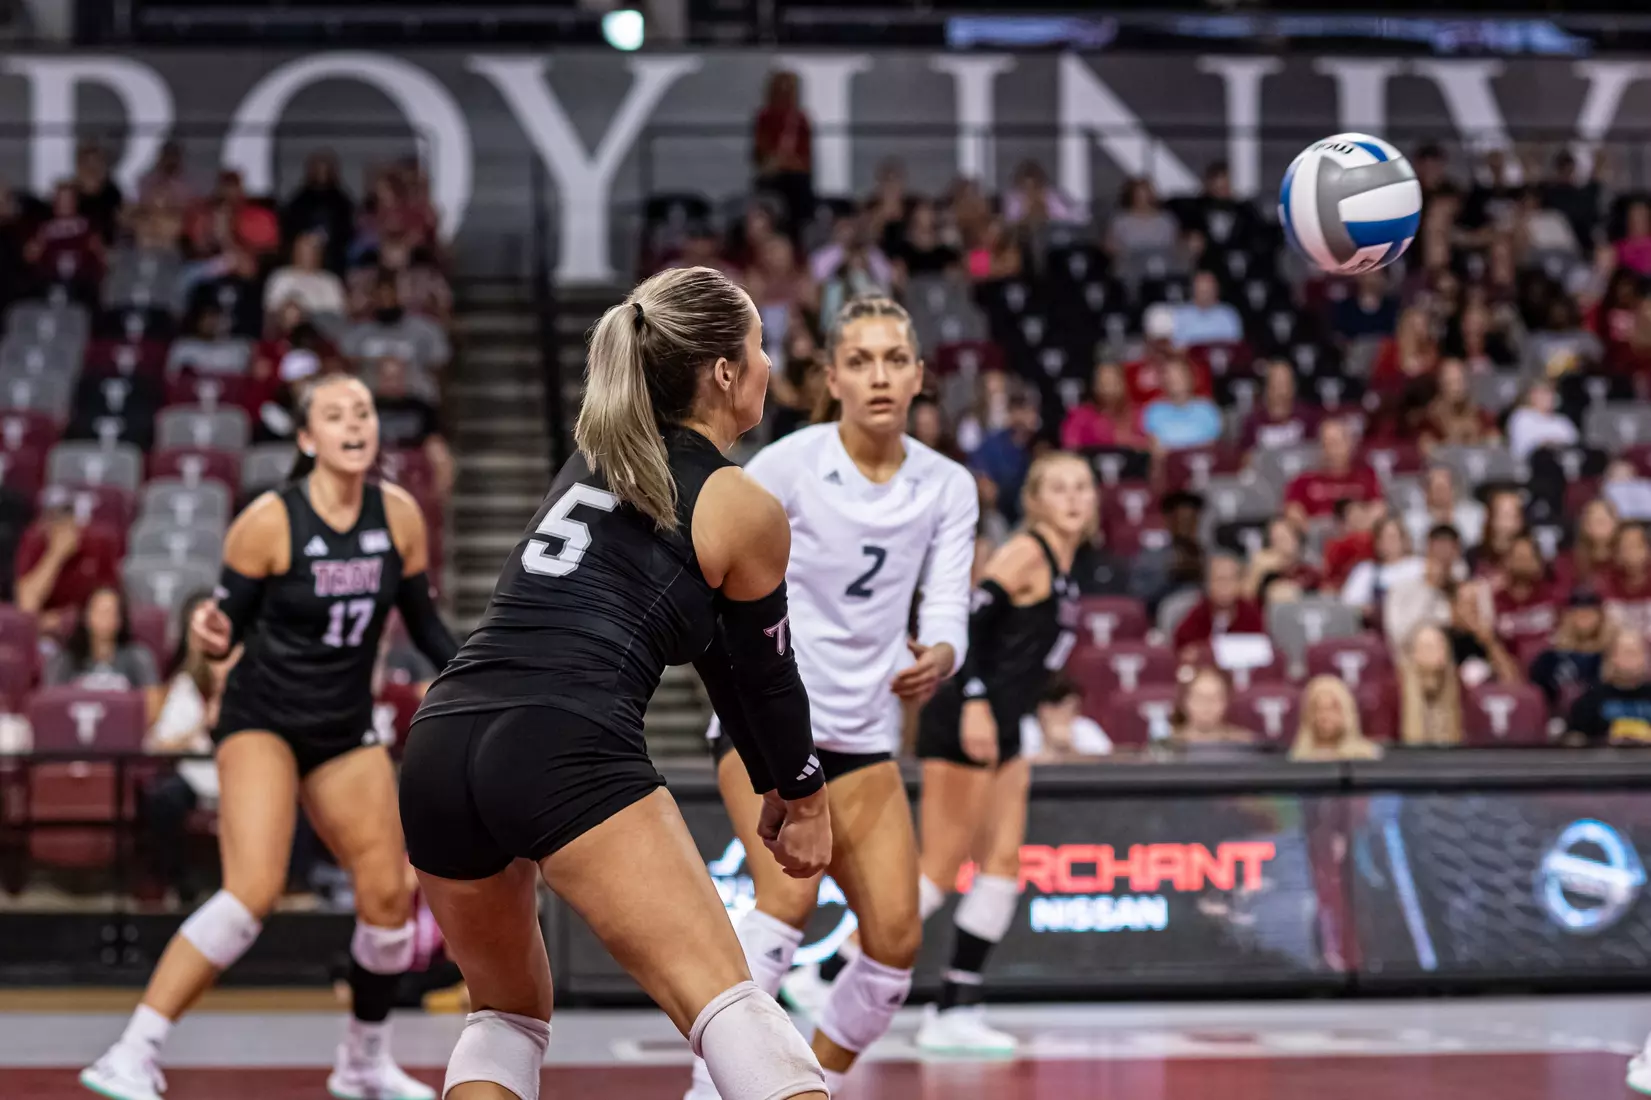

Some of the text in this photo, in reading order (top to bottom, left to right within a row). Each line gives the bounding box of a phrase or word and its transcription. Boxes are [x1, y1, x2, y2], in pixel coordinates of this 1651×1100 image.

[521, 482, 620, 578] 5
[311, 557, 383, 597] TROY
[845, 546, 887, 598] 2
[322, 598, 376, 648] 17
[955, 842, 1276, 894] RCHANT
[1030, 894, 1169, 933] NISSAN
